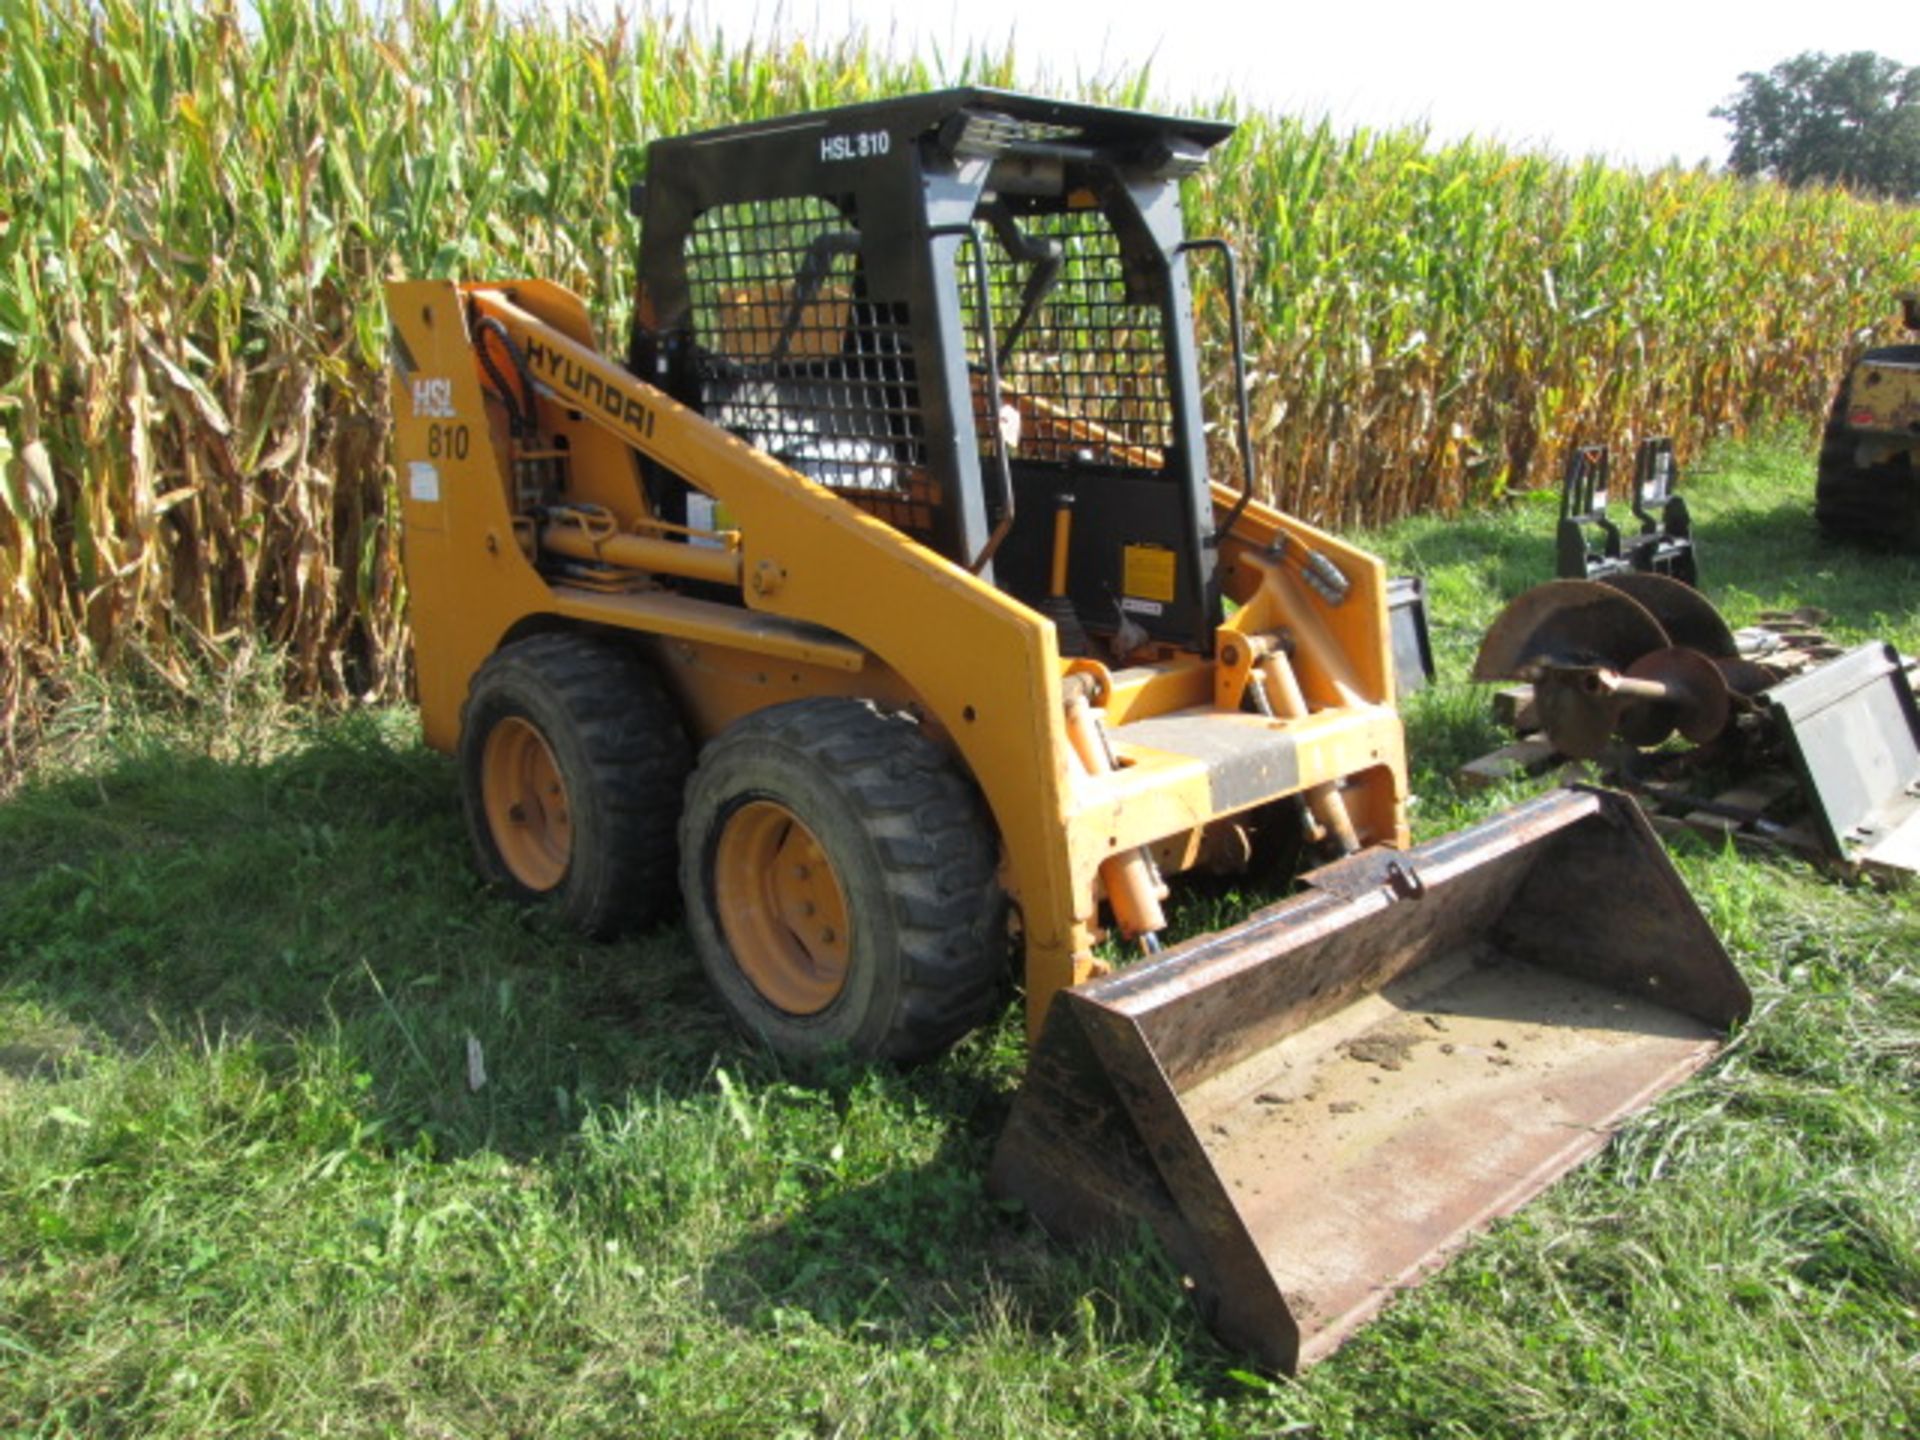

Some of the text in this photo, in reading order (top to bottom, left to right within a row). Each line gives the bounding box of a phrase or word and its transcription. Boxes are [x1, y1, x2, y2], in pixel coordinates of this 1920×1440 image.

[821, 130, 889, 161] HSL 810
[412, 378, 456, 418] HSL
[526, 336, 656, 439] HYUNDAI
[428, 423, 469, 461] 810
